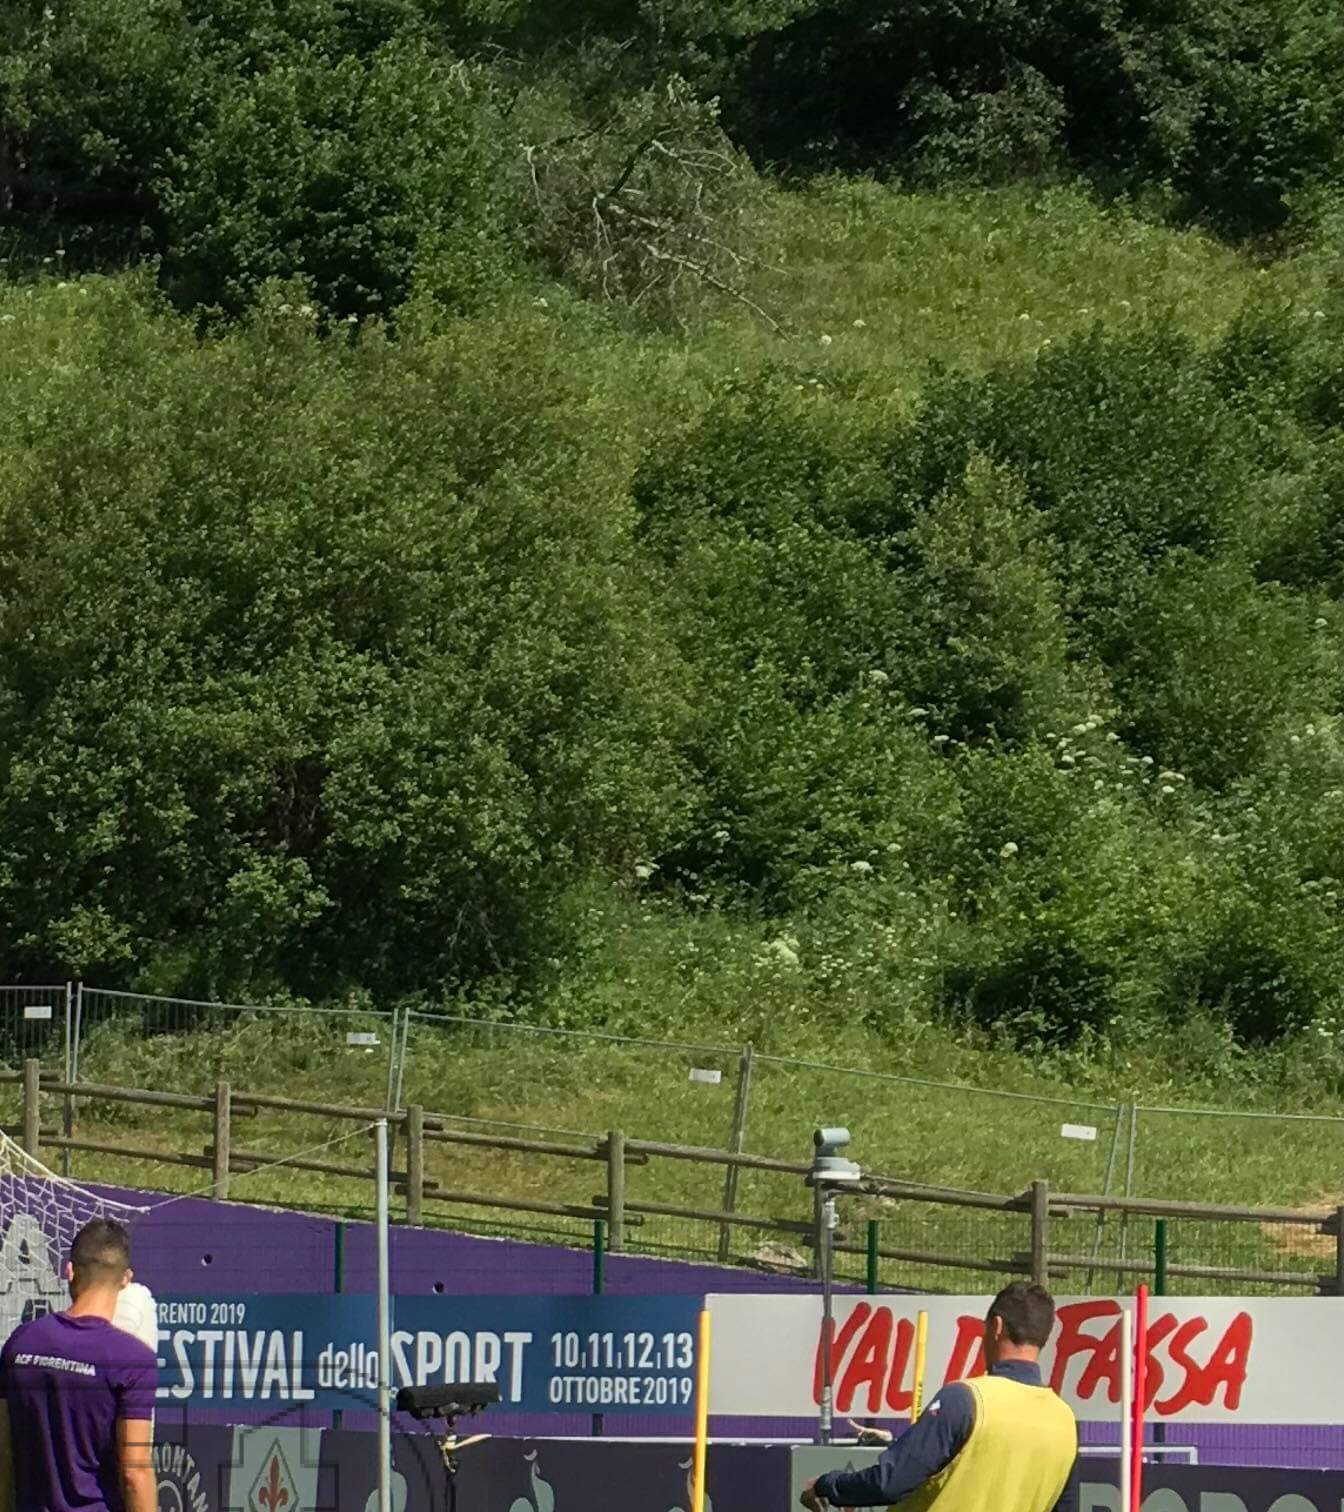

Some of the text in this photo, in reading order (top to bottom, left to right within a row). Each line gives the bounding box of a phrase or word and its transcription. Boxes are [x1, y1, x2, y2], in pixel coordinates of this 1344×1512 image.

[210, 1303, 246, 1325] 2019
[155, 1330, 533, 1402] ESTIVAL dello SPORT
[813, 1301, 914, 1413] VAL
[550, 1376, 693, 1405] OTTOBRE 2019
